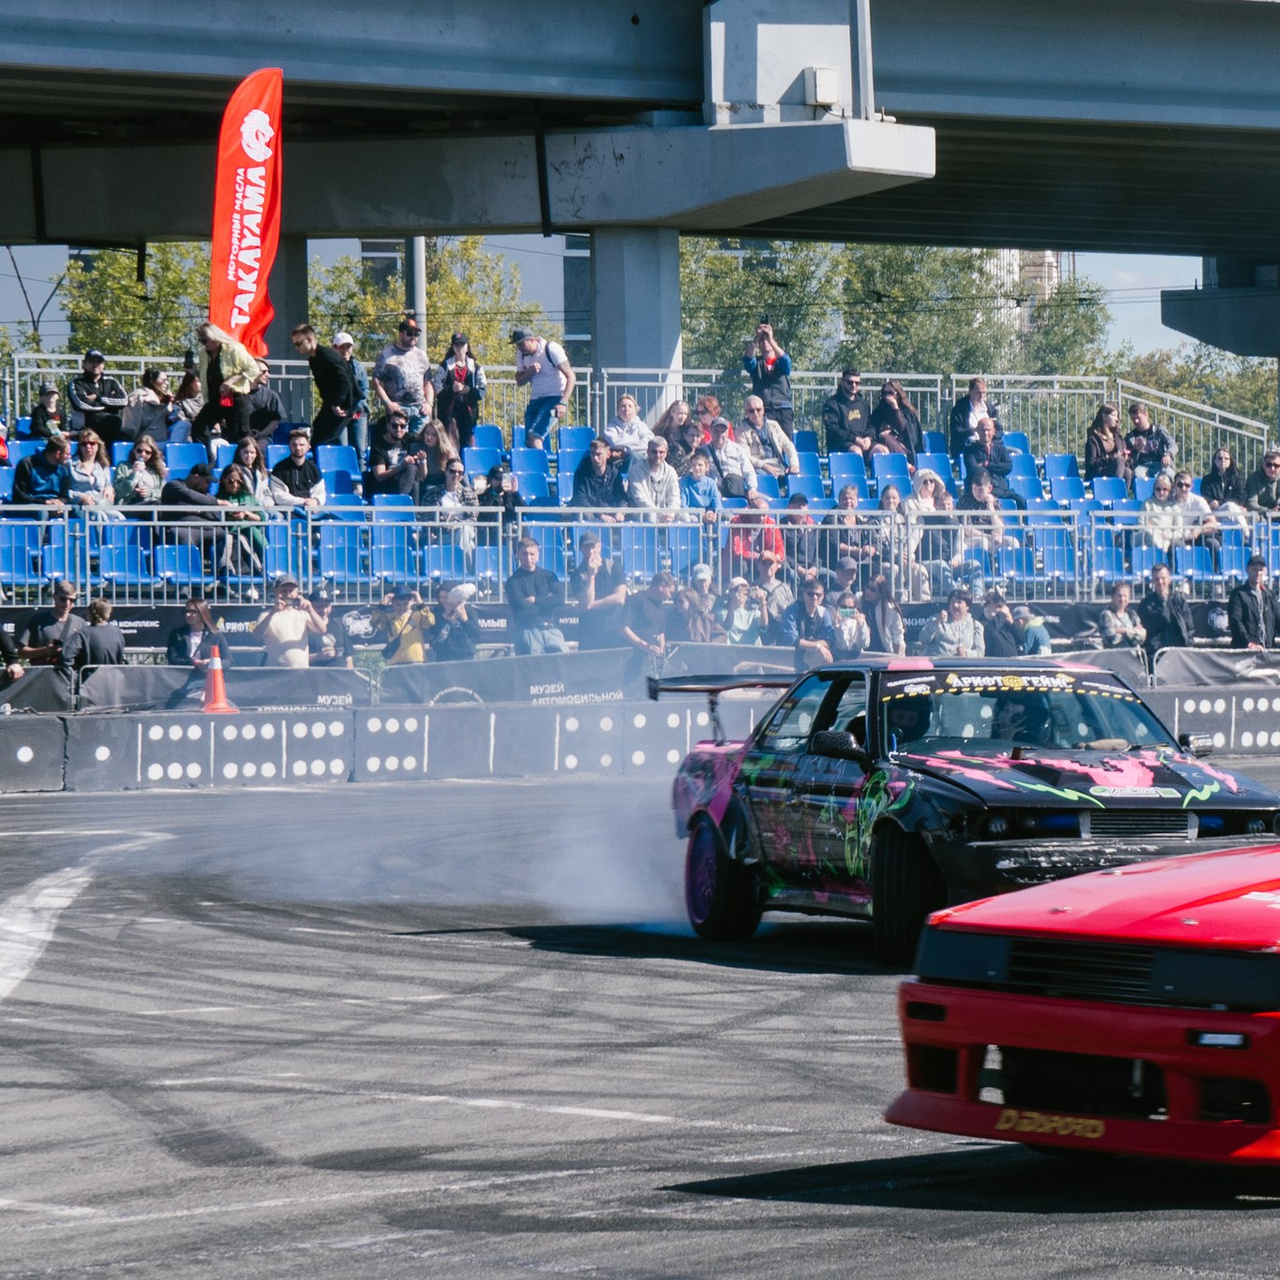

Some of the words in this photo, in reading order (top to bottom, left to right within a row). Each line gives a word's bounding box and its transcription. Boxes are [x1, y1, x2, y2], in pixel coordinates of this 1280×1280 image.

[227, 213, 241, 281] МОТОРНЫЕ
[234, 167, 245, 211] МАСЛА
[230, 166, 266, 329] TAKAYAMA
[317, 693, 353, 706] МУЗЕЙ
[530, 682, 565, 696] МУЗЕЙ
